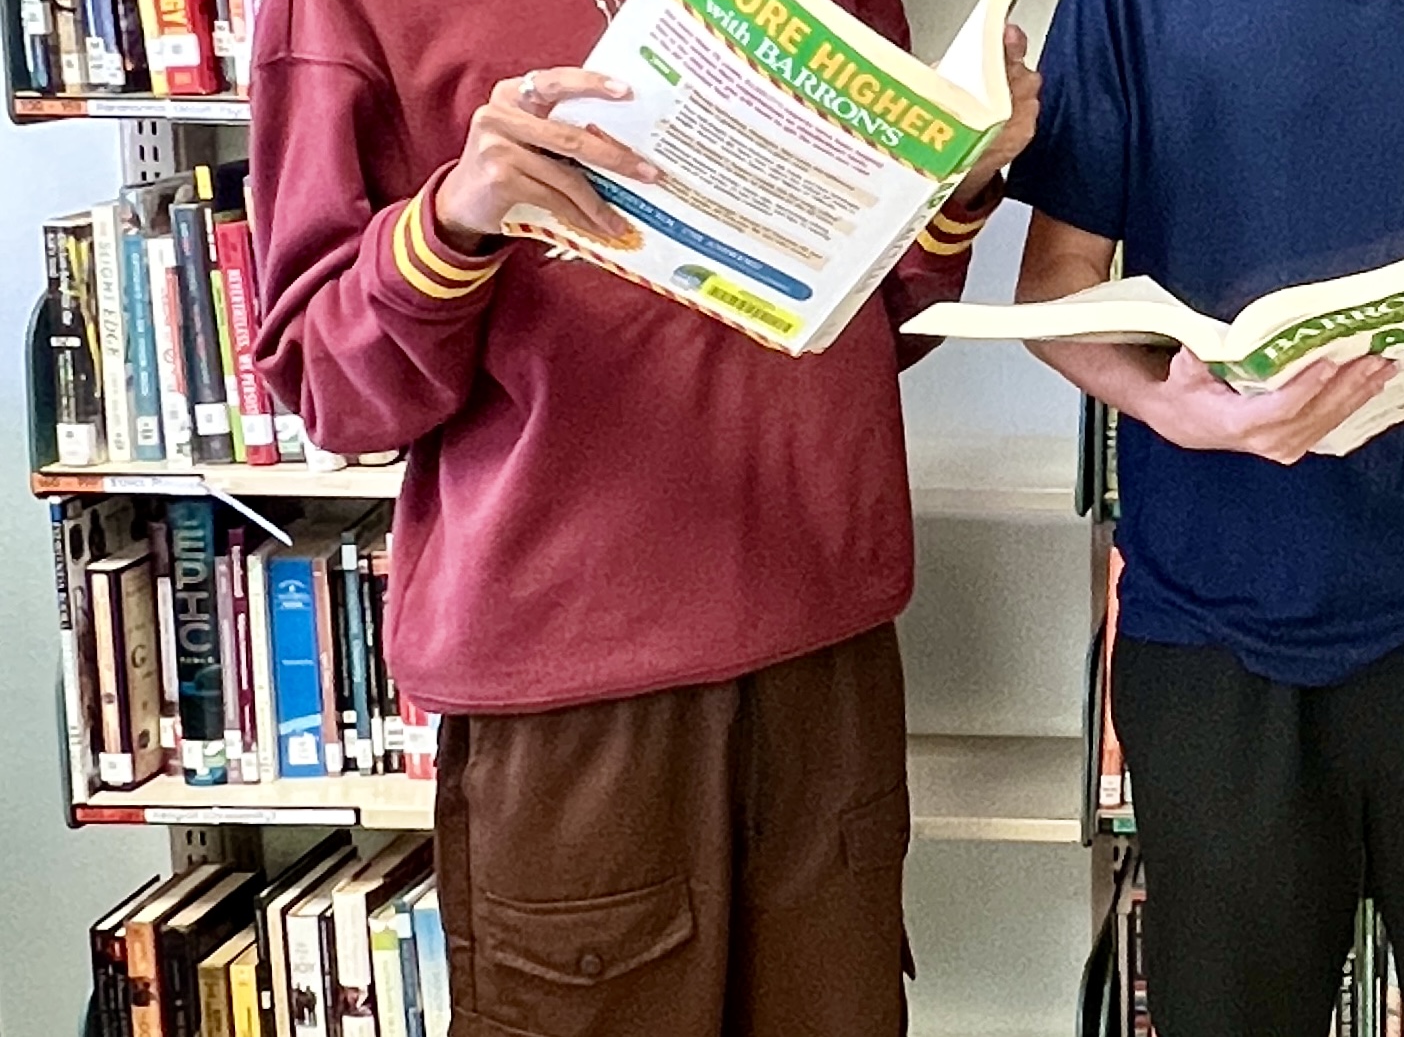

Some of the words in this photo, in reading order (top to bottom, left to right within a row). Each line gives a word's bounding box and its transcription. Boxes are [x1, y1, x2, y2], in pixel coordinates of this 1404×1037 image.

[753, 38, 905, 150] BARRON'S
[808, 39, 954, 154] HIGHER
[102, 307, 121, 359] EDGE
